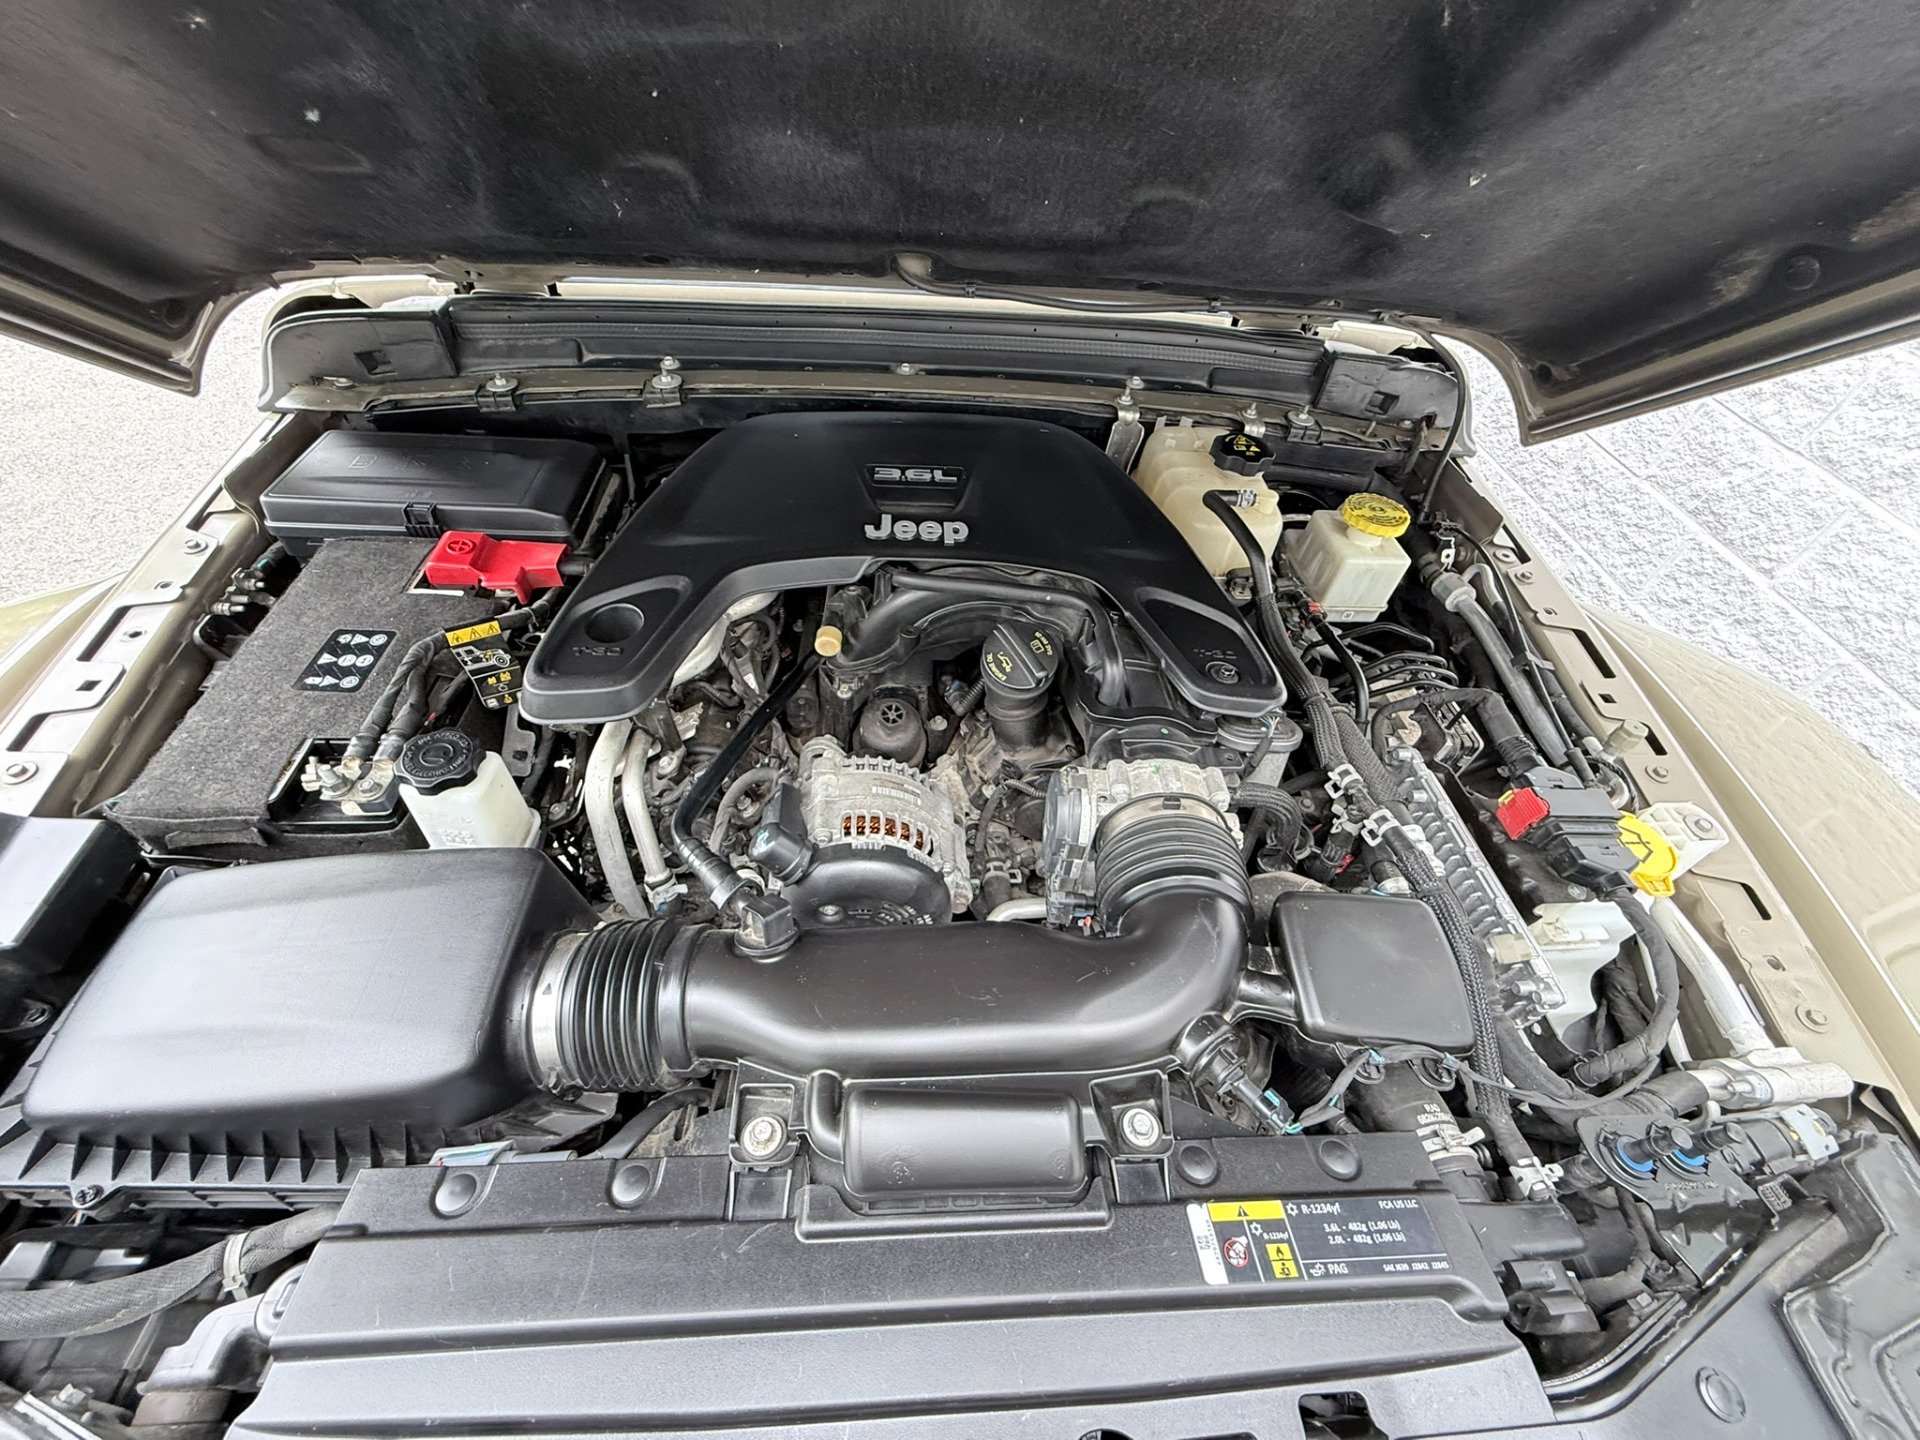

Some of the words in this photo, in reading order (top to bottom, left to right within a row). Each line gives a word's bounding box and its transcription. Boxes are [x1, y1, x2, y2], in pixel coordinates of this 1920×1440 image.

[873, 467, 958, 483] 3.6L
[864, 513, 969, 546] Jeep
[988, 662, 1007, 682] ENGINE
[1302, 1202, 1341, 1215] R-1234yf
[1378, 1200, 1394, 1210] FCA
[1394, 1200, 1405, 1209] US
[1405, 1199, 1419, 1208] LLC
[1323, 1223, 1341, 1233] 3.6L
[1328, 1235, 1346, 1245] 2.0L
[1327, 1263, 1349, 1274] PAG
